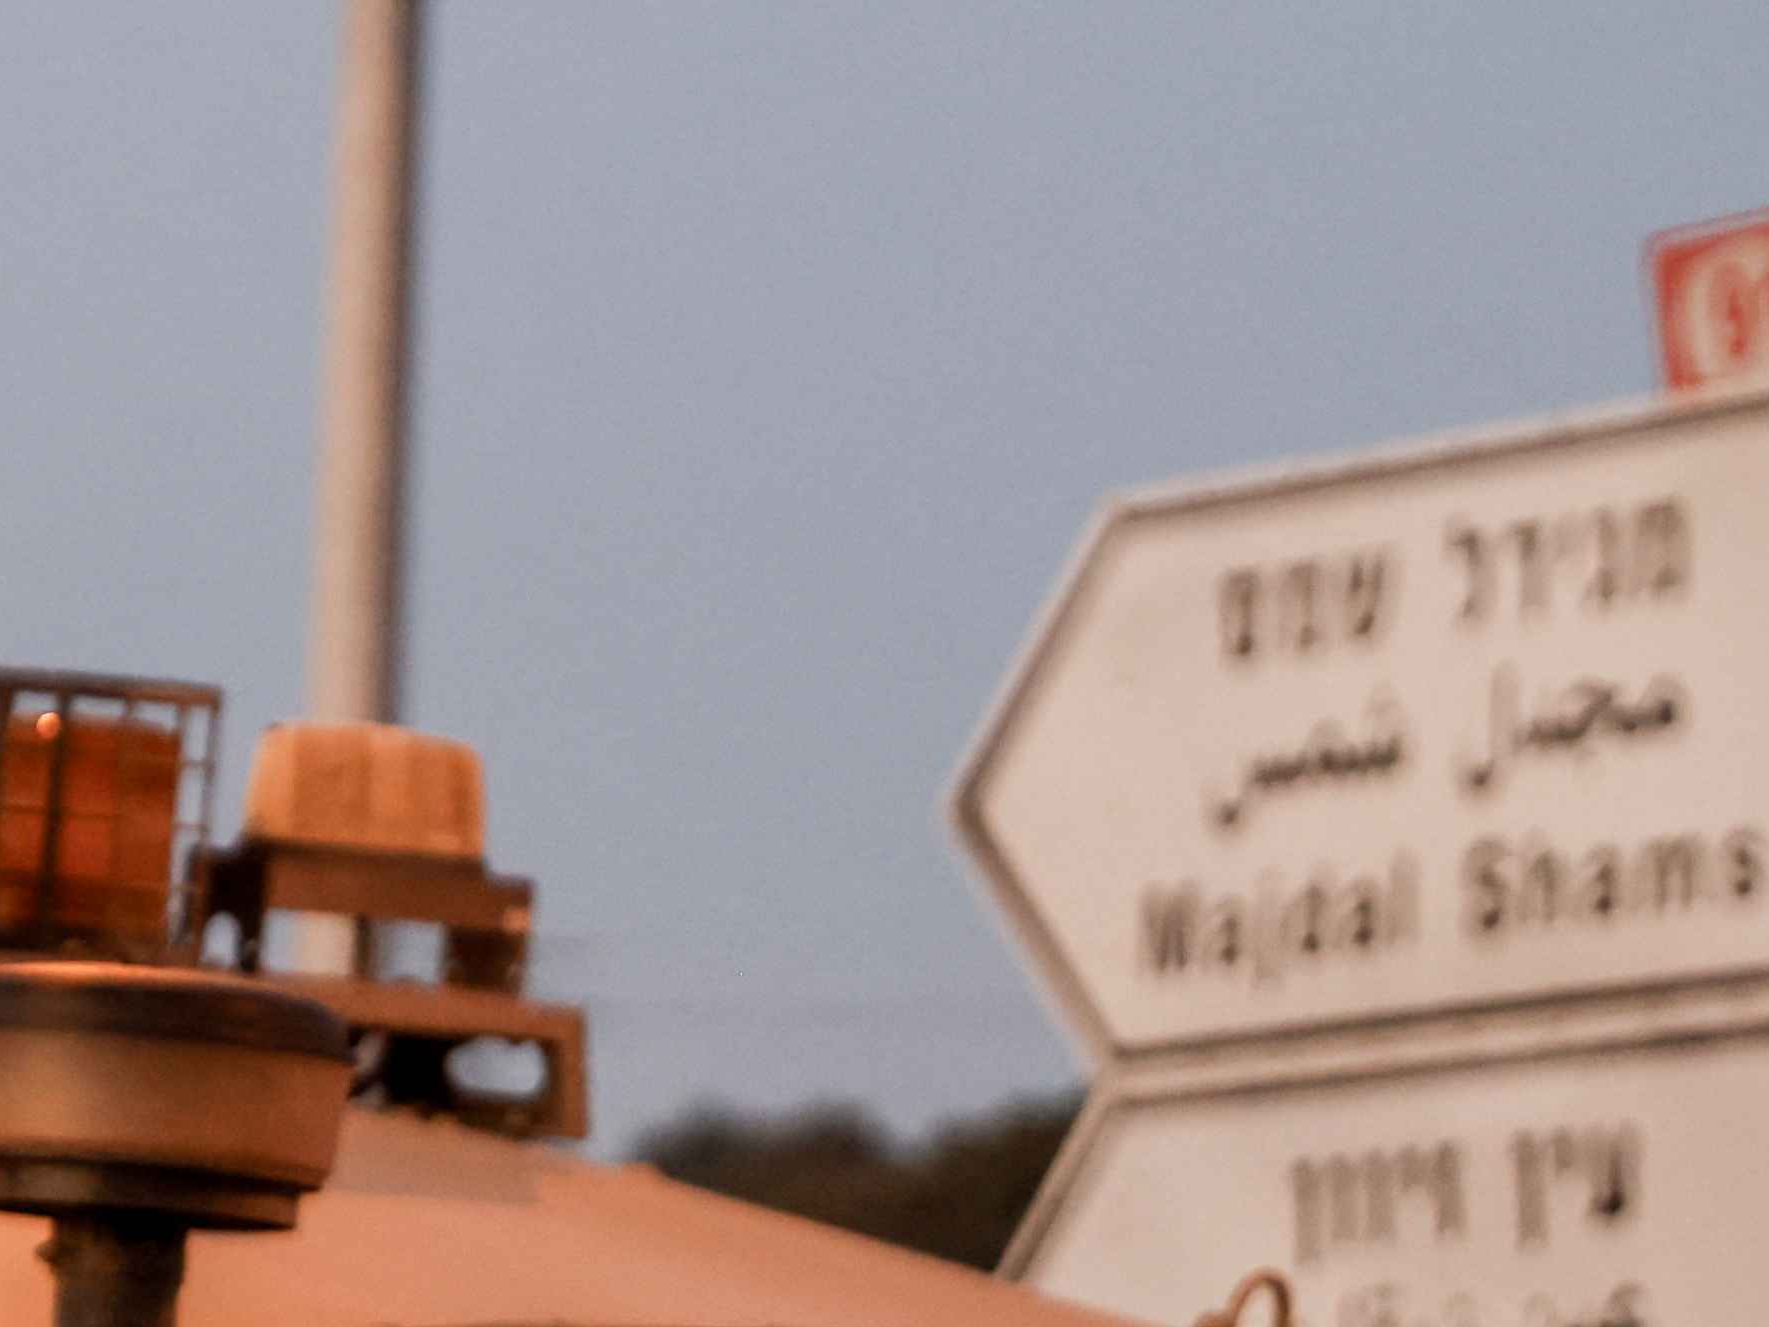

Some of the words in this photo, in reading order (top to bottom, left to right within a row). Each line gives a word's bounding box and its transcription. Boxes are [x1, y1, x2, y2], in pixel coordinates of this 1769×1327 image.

[1217, 551, 1395, 668] שמס
[1207, 692, 1410, 836] شمس
[1460, 664, 1689, 792] مجدل
[1138, 858, 1419, 986] Majdal
[1462, 827, 1768, 952] Shams
[1508, 1126, 1642, 1249] עין
